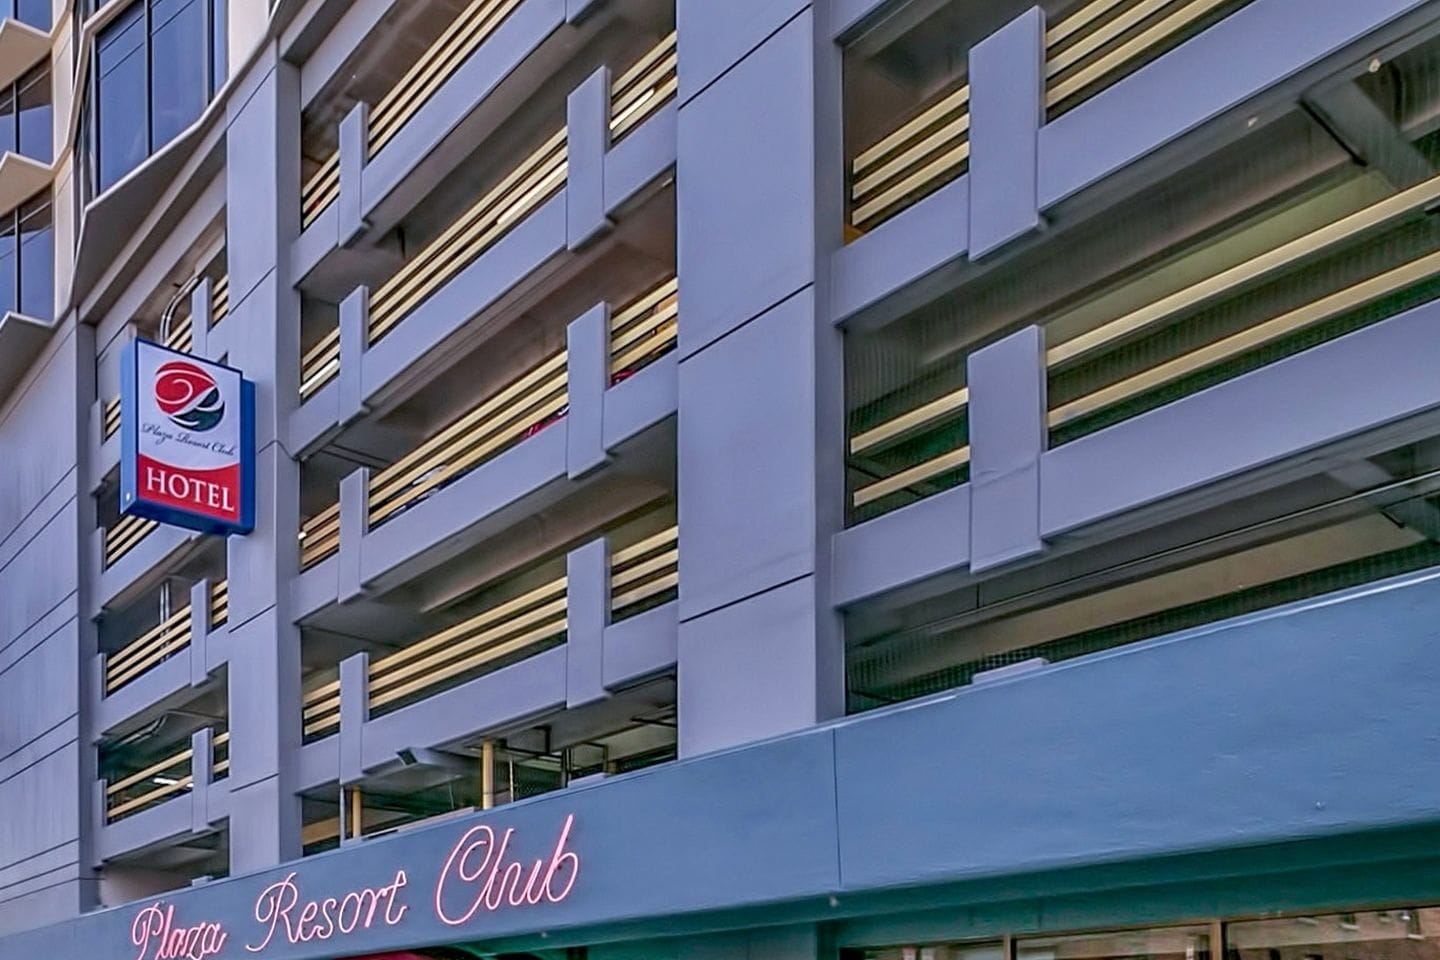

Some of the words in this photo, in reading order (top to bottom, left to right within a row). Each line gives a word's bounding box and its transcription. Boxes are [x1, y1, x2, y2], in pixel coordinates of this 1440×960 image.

[143, 424, 173, 446] Plaza
[211, 441, 236, 456] Club
[146, 466, 235, 511] HOTEL
[246, 871, 408, 952] Resort
[436, 814, 579, 925] Club
